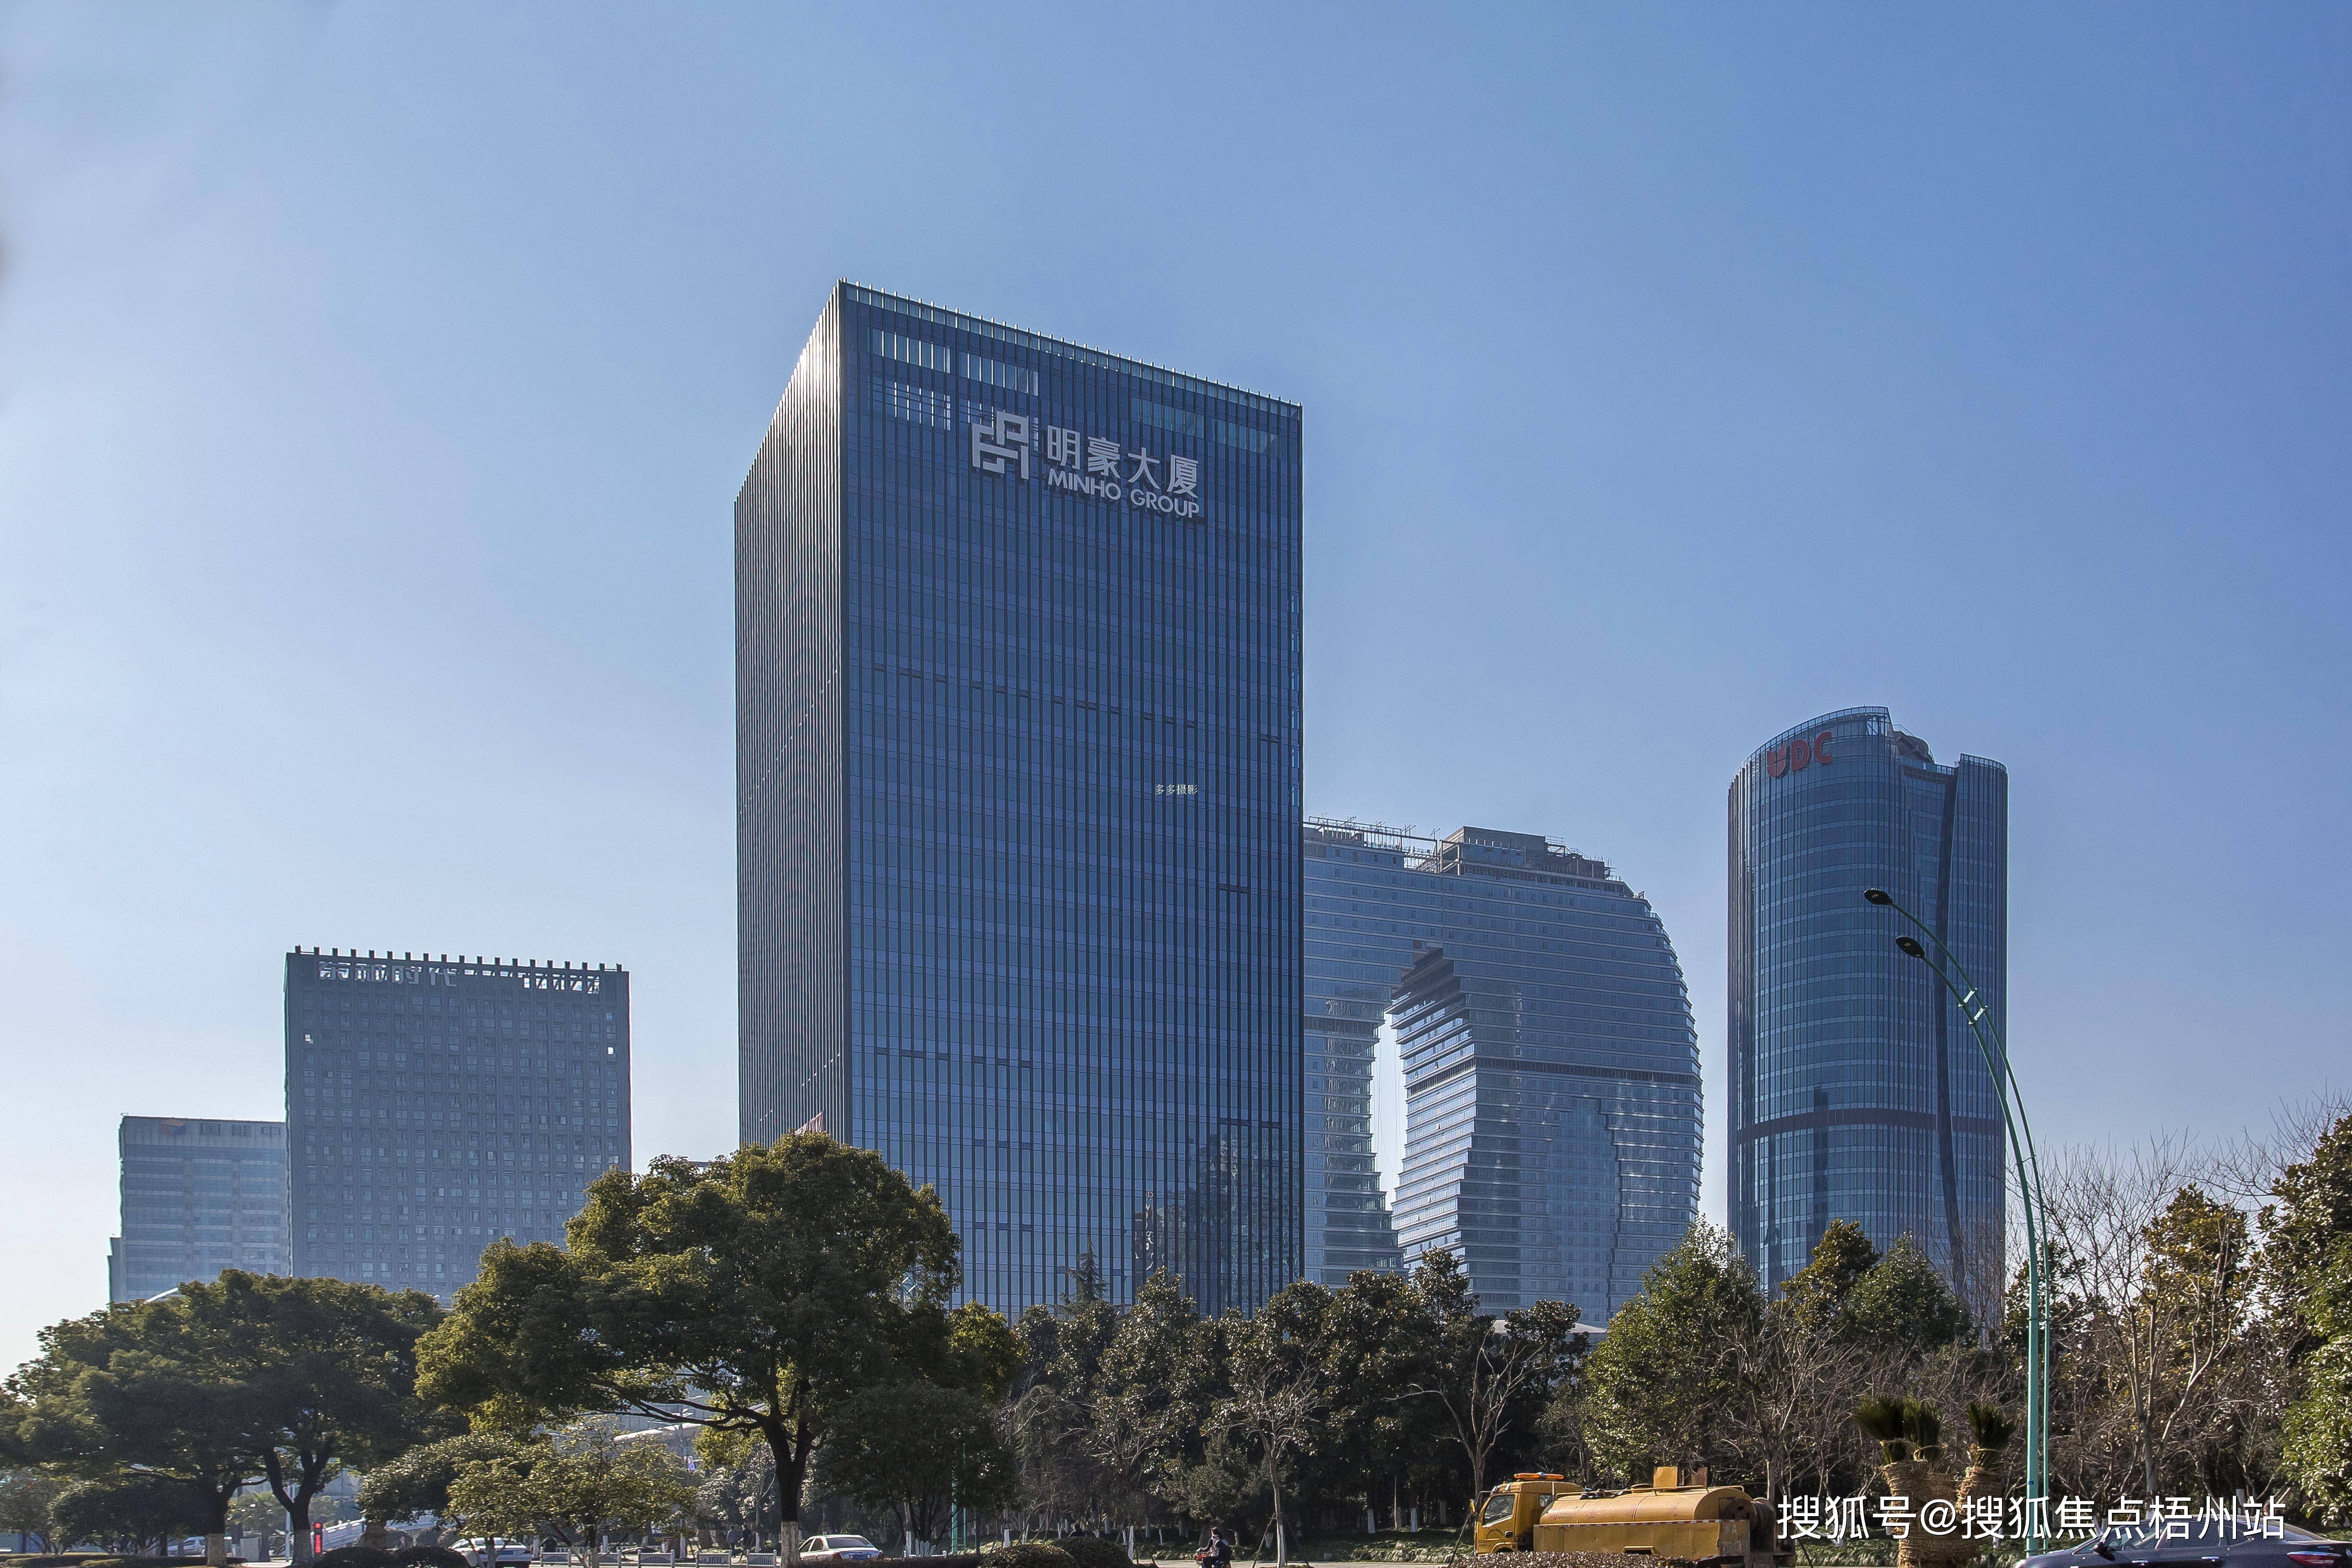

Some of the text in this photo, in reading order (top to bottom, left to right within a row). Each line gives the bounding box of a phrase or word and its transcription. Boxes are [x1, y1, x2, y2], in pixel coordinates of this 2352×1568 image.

[1047, 425, 1198, 498] 明豪大厦
[1048, 468, 1200, 519] MINHO GROUP
[1766, 731, 1833, 778] UDC
